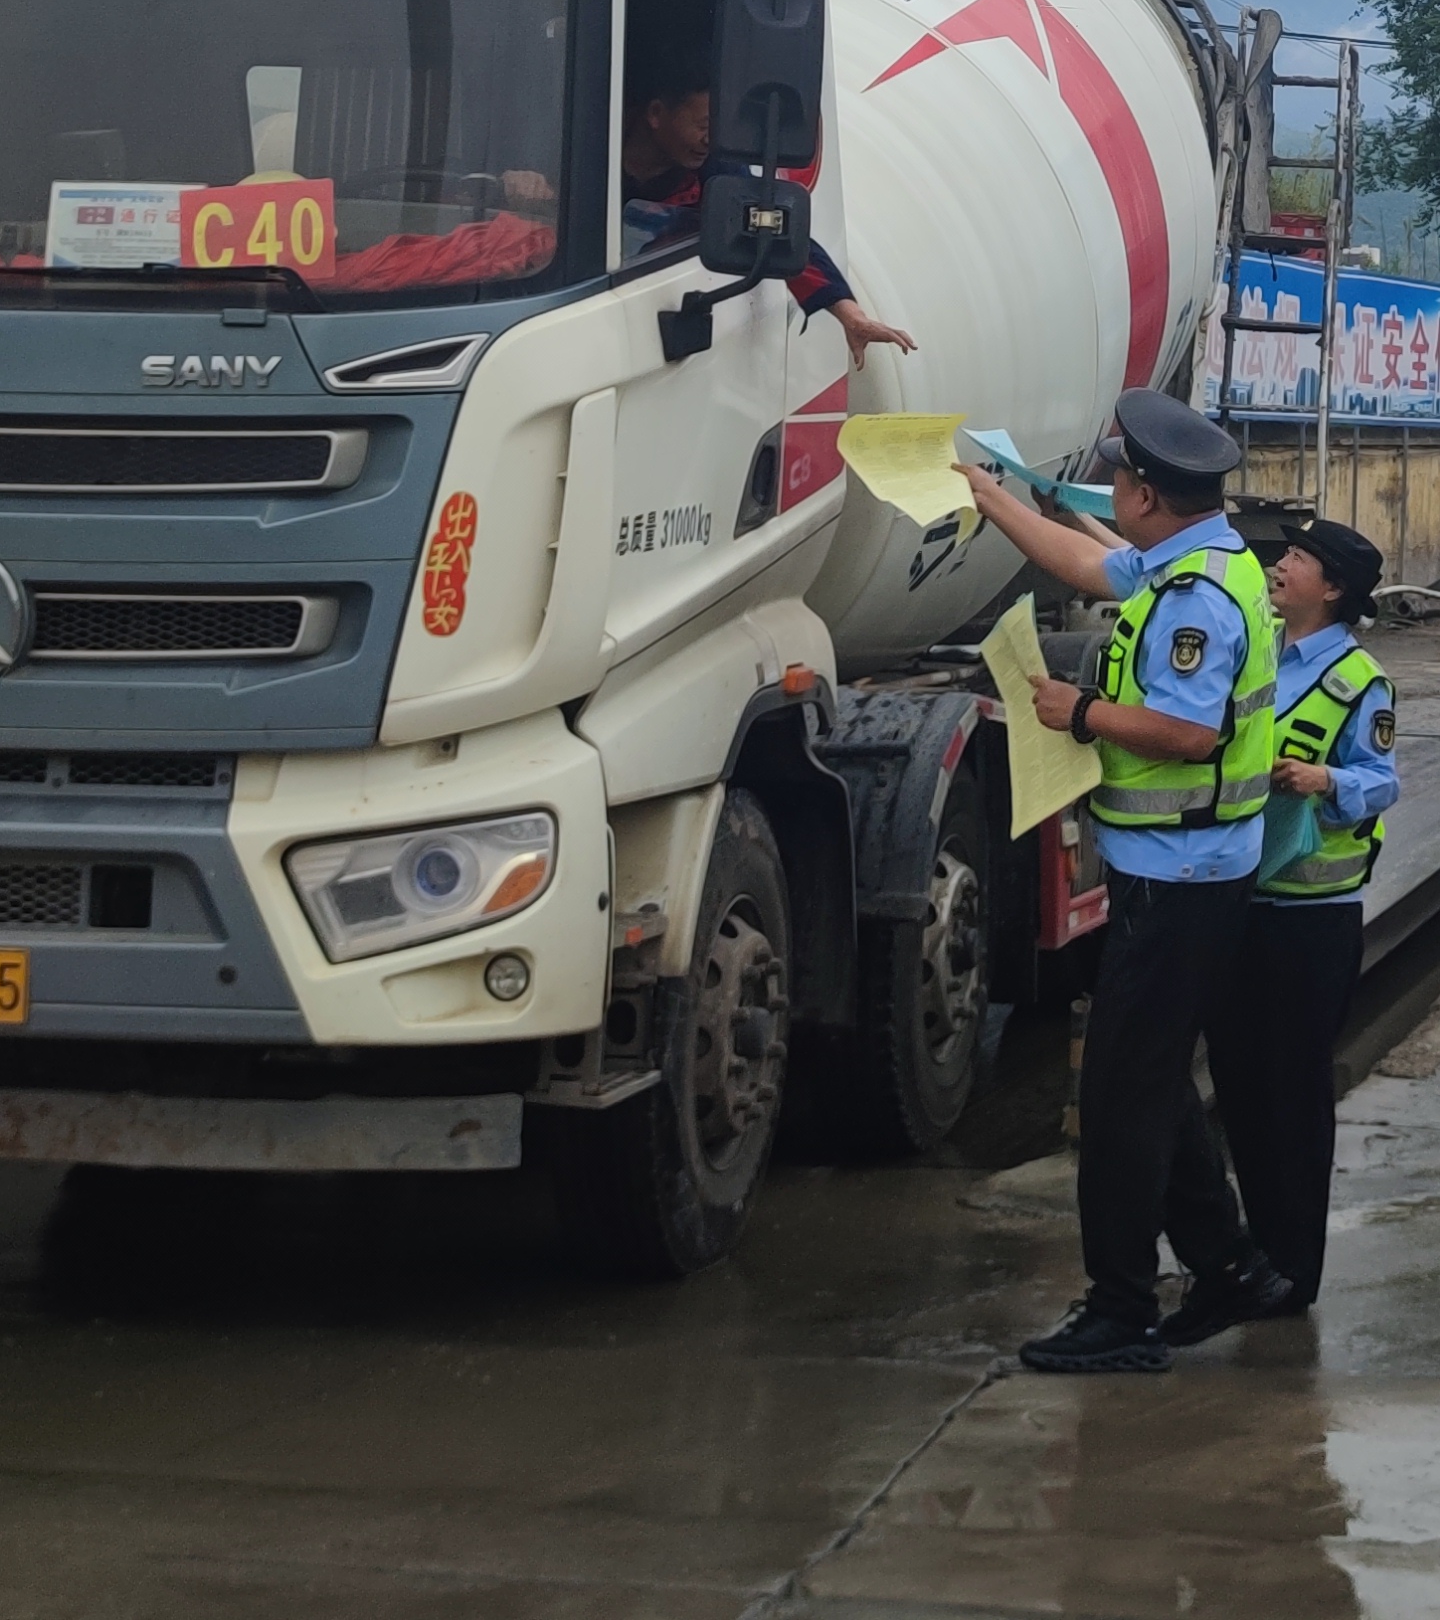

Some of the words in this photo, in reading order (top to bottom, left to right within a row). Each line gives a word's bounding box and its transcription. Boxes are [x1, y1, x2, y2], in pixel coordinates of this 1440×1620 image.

[193, 197, 324, 267] C40
[141, 355, 283, 387] SANY
[661, 502, 712, 548] 31000kg
